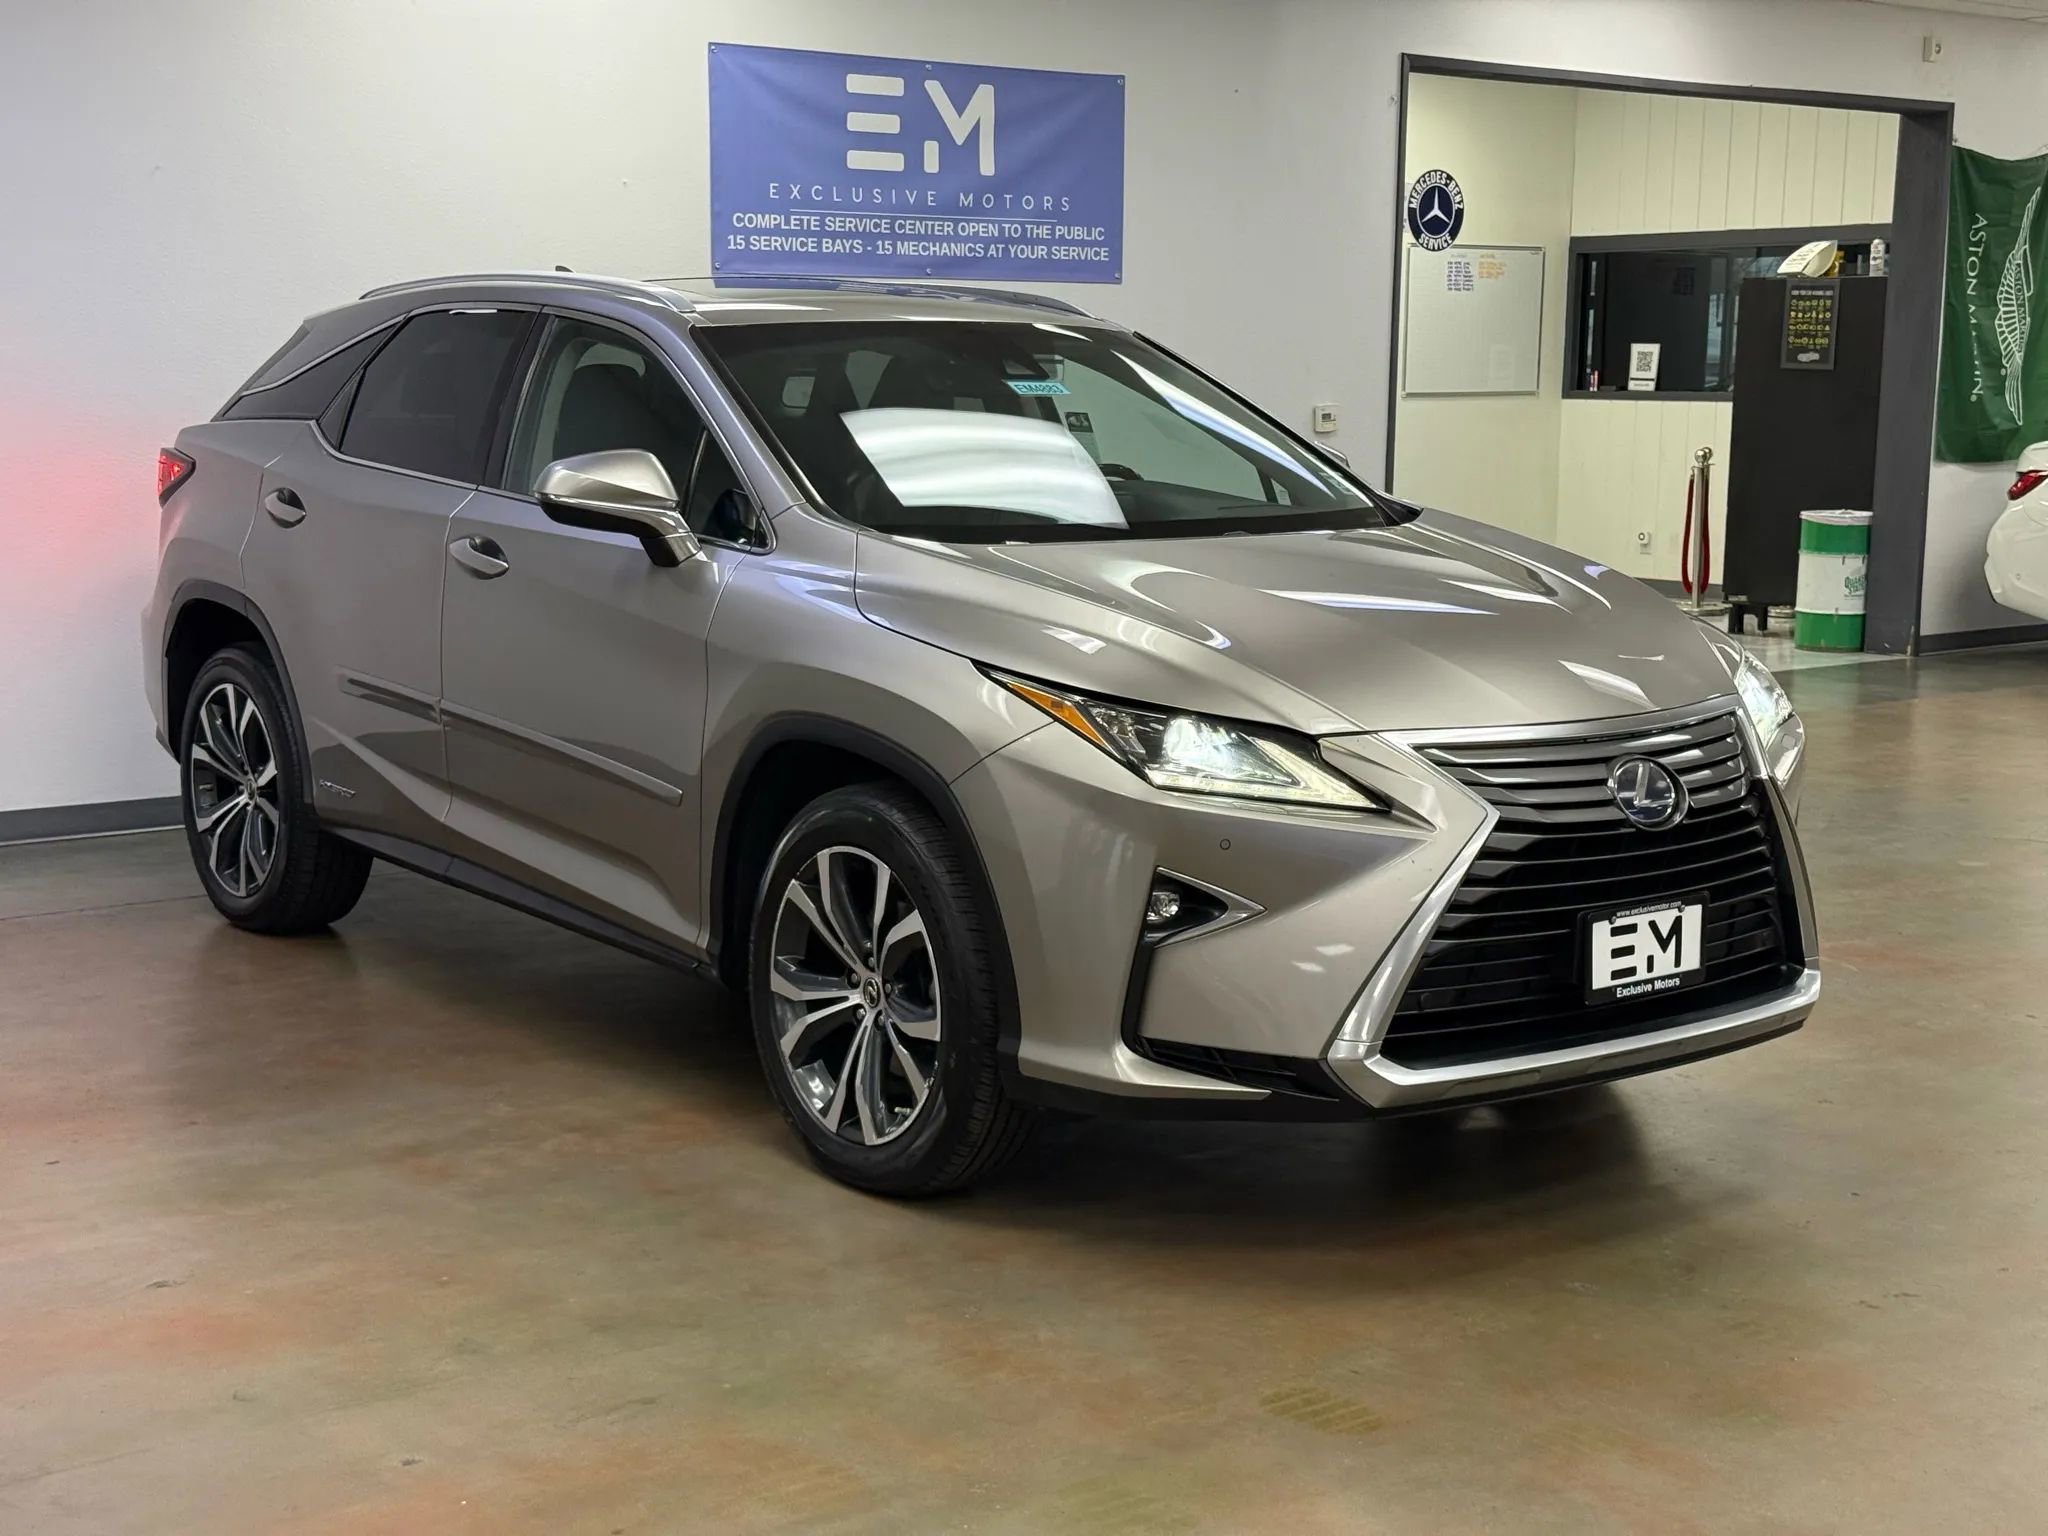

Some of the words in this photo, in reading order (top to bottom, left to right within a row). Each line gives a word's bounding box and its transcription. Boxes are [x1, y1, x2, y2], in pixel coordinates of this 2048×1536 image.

[846, 73, 995, 177] EM
[769, 183, 937, 206] EXCLUSIVE
[959, 192, 1070, 212] MOTORS
[1408, 171, 1464, 210] MERCEDES-BENZ
[732, 212, 821, 231] COMPLETE
[825, 216, 891, 233] SERVICE
[894, 219, 954, 236] CENTER
[958, 222, 999, 237] OPEN
[1002, 223, 1022, 238] TO
[1025, 224, 1052, 239] THE
[1055, 225, 1105, 241] PUBLIC
[1419, 233, 1453, 250] SERVICE
[727, 234, 746, 250] 15
[750, 236, 818, 252] SERVICE
[822, 238, 863, 254] BAYS
[876, 240, 893, 255] 15
[896, 241, 985, 257] MECHANICS
[987, 244, 1005, 258] AT
[1008, 245, 1048, 259] YOUR
[1051, 246, 1110, 261] SERVICE
[1966, 213, 1988, 295] ASTON
[2013, 264, 2025, 304] ASTON
[1610, 915, 1683, 981] EM
[1616, 983, 1652, 998] Exclusive
[1654, 977, 1680, 990] Motors
